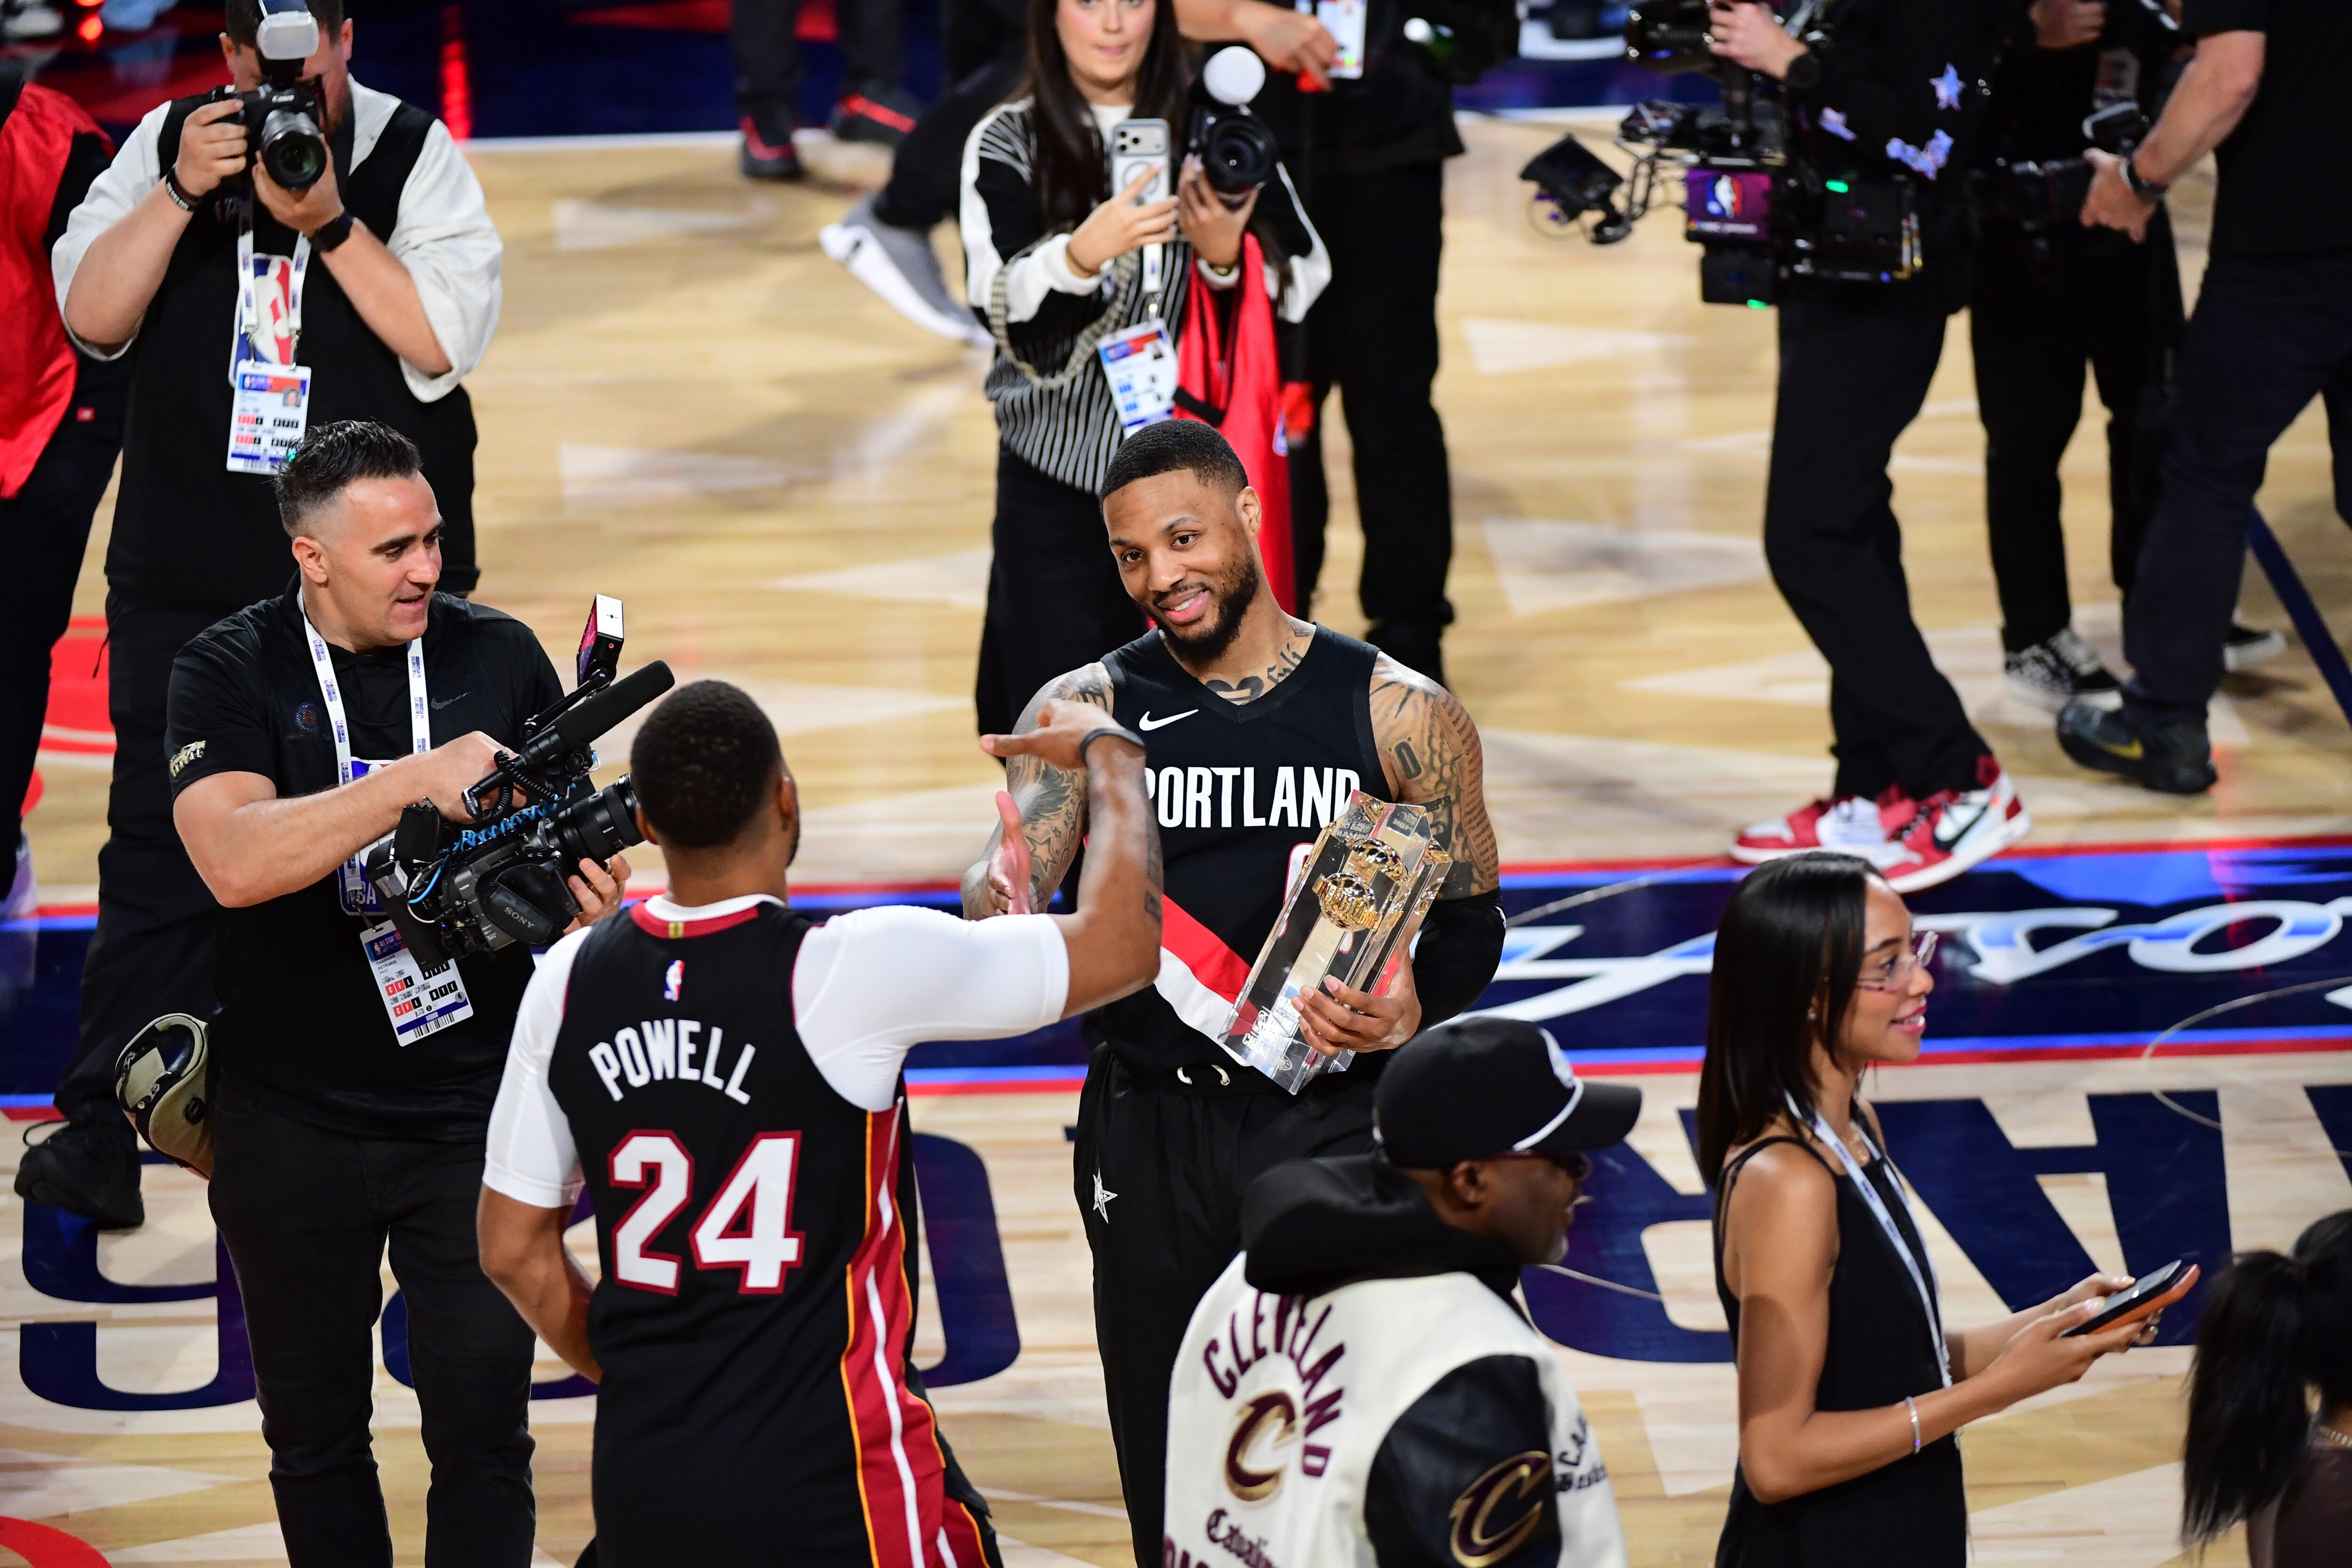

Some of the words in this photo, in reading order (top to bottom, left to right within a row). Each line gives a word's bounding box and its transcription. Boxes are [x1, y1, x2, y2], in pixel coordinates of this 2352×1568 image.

[346, 880, 377, 905] BA
[504, 907, 535, 929] SONY
[376, 954, 396, 965] THANASIS
[378, 961, 397, 970] PETRAKIS
[588, 1019, 756, 1105] POWELL
[607, 1128, 806, 1297] 24
[1202, 1289, 1346, 1478] CLEVELAND
